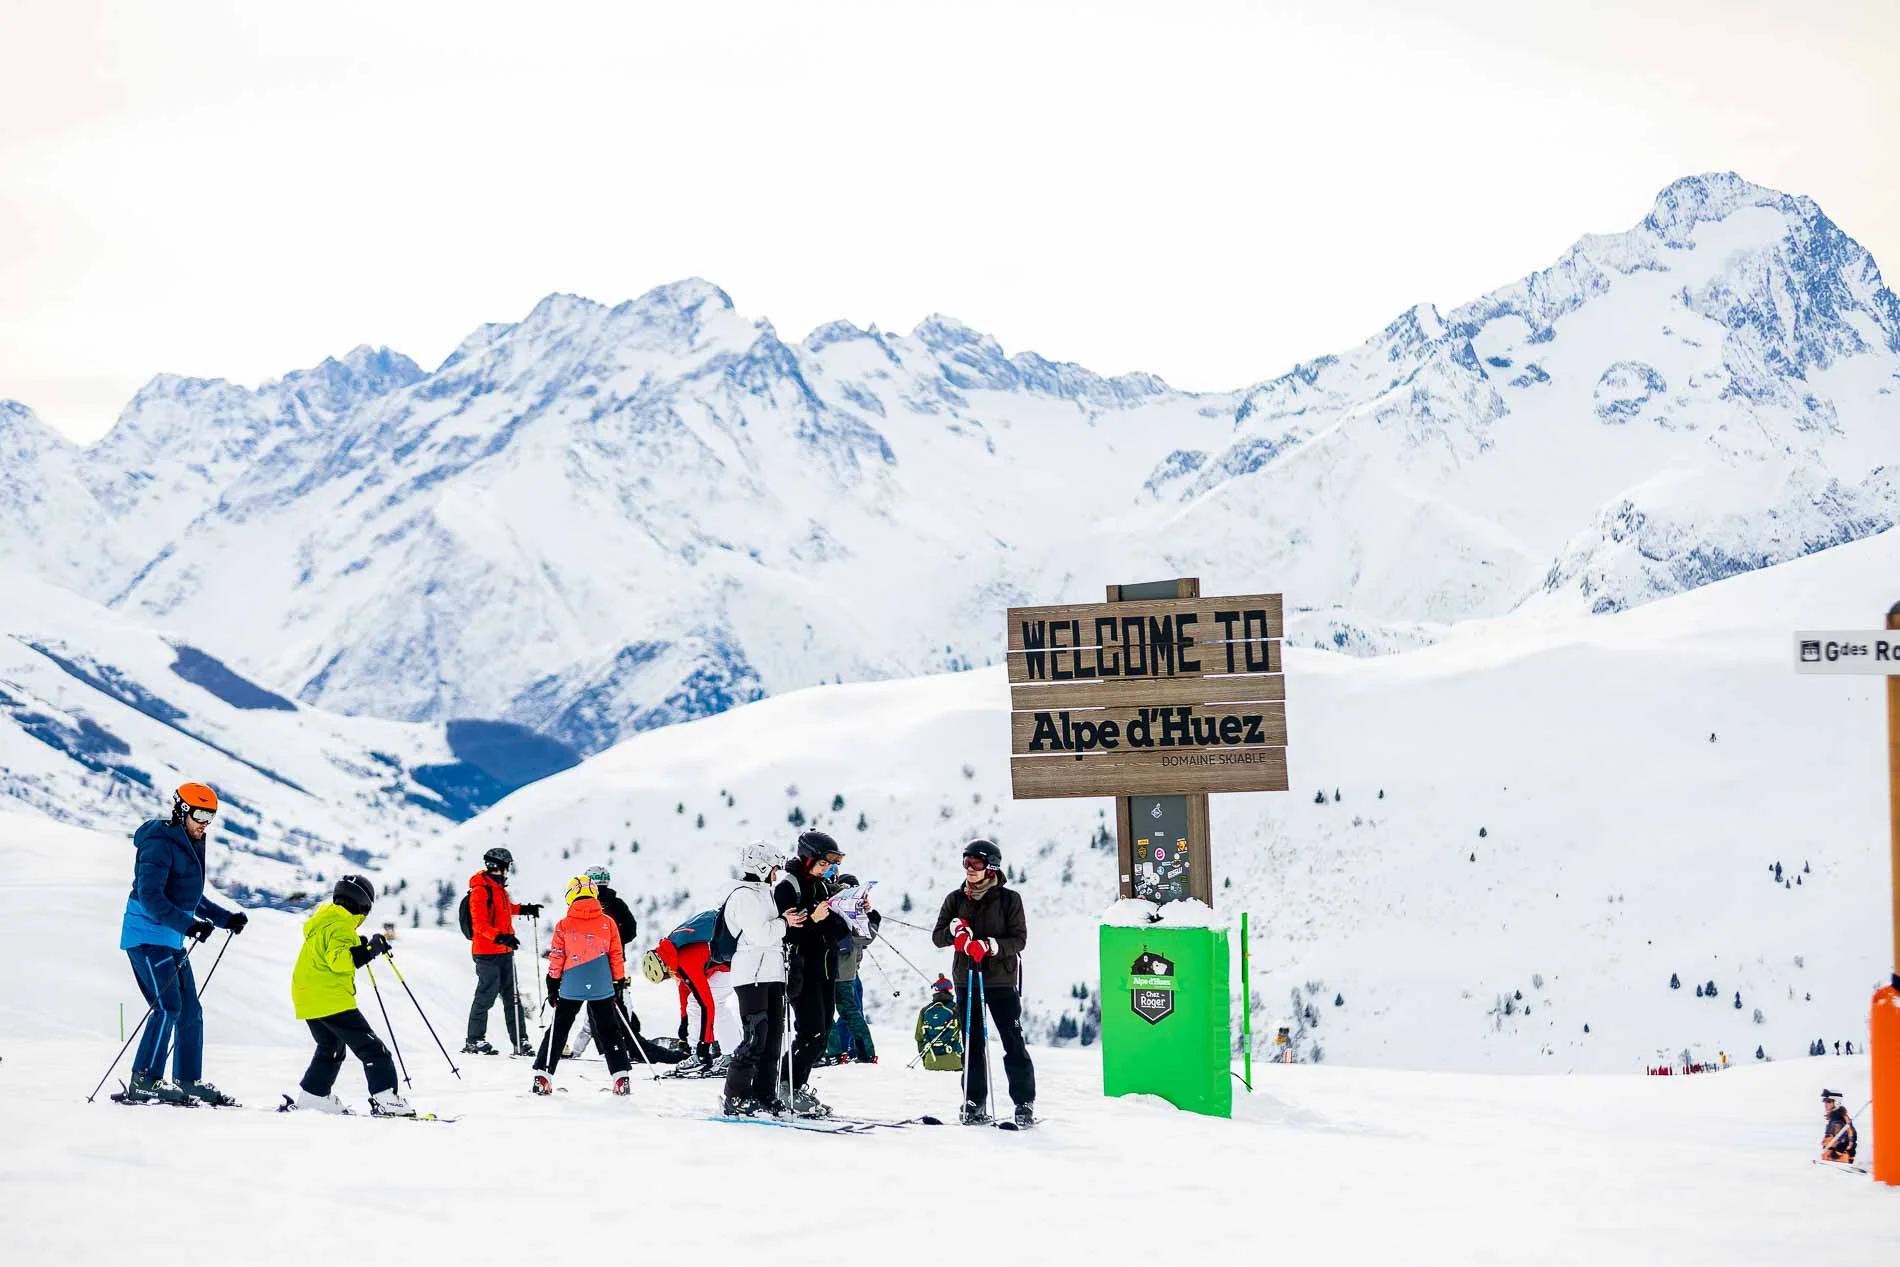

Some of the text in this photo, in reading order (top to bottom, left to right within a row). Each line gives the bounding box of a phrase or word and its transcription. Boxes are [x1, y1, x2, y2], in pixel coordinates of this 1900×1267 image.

[1021, 610, 1270, 680] WELCOME TO
[1825, 641, 1868, 661] Gdes
[1029, 706, 1265, 761] Alpe d'Huez
[1162, 752, 1267, 767] DOMAINE SKIABLE
[1140, 996, 1166, 1009] Roger
